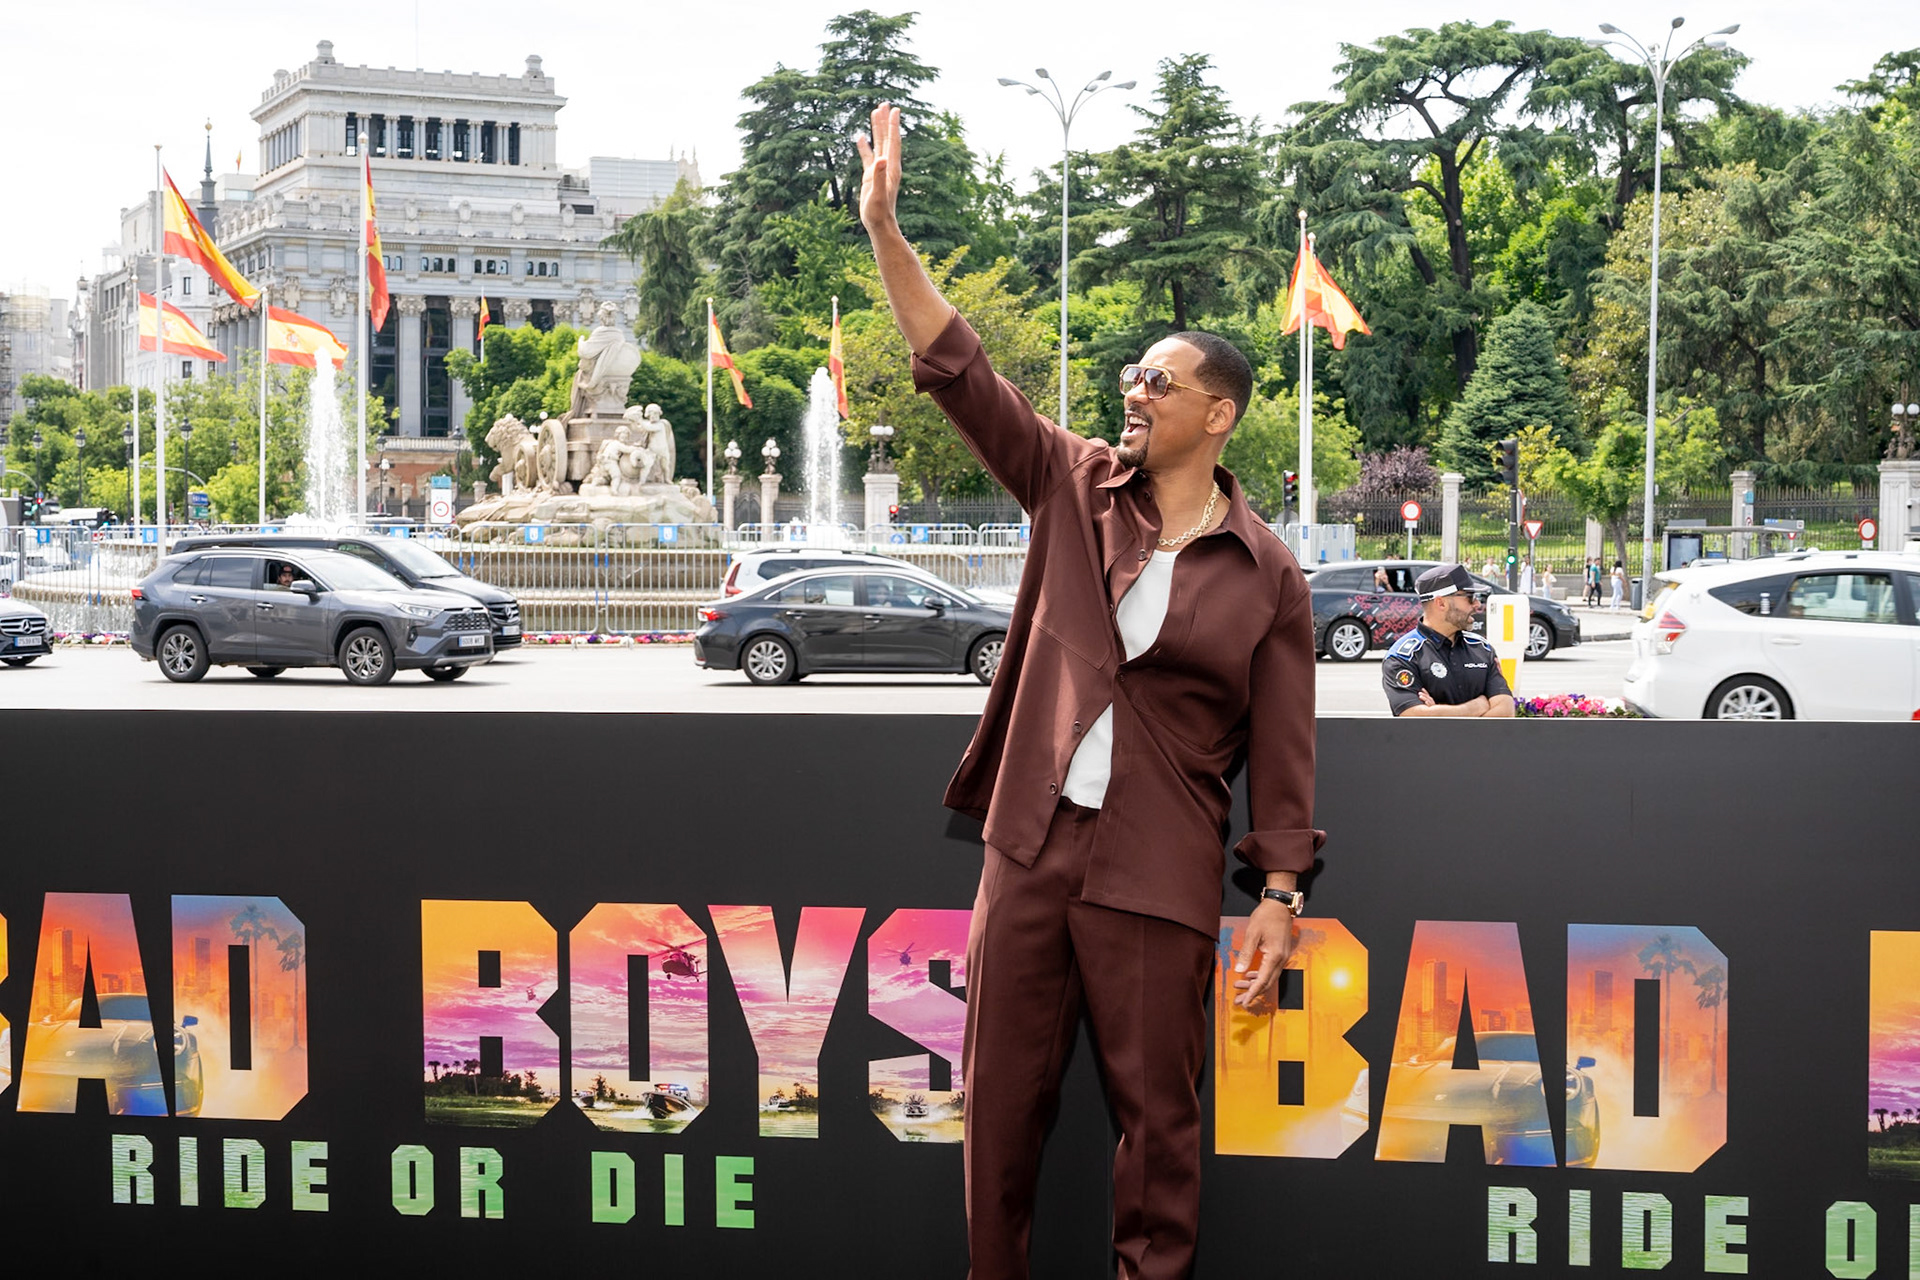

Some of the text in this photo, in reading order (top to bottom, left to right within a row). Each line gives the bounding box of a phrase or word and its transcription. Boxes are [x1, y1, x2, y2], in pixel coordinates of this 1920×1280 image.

[1473, 621, 1484, 630] er
[0, 892, 971, 1143] AD BOYS
[1215, 917, 1729, 1173] BAD
[112, 1134, 755, 1228] RIDE OR DIE
[1488, 1186, 1920, 1280] RIDE O
